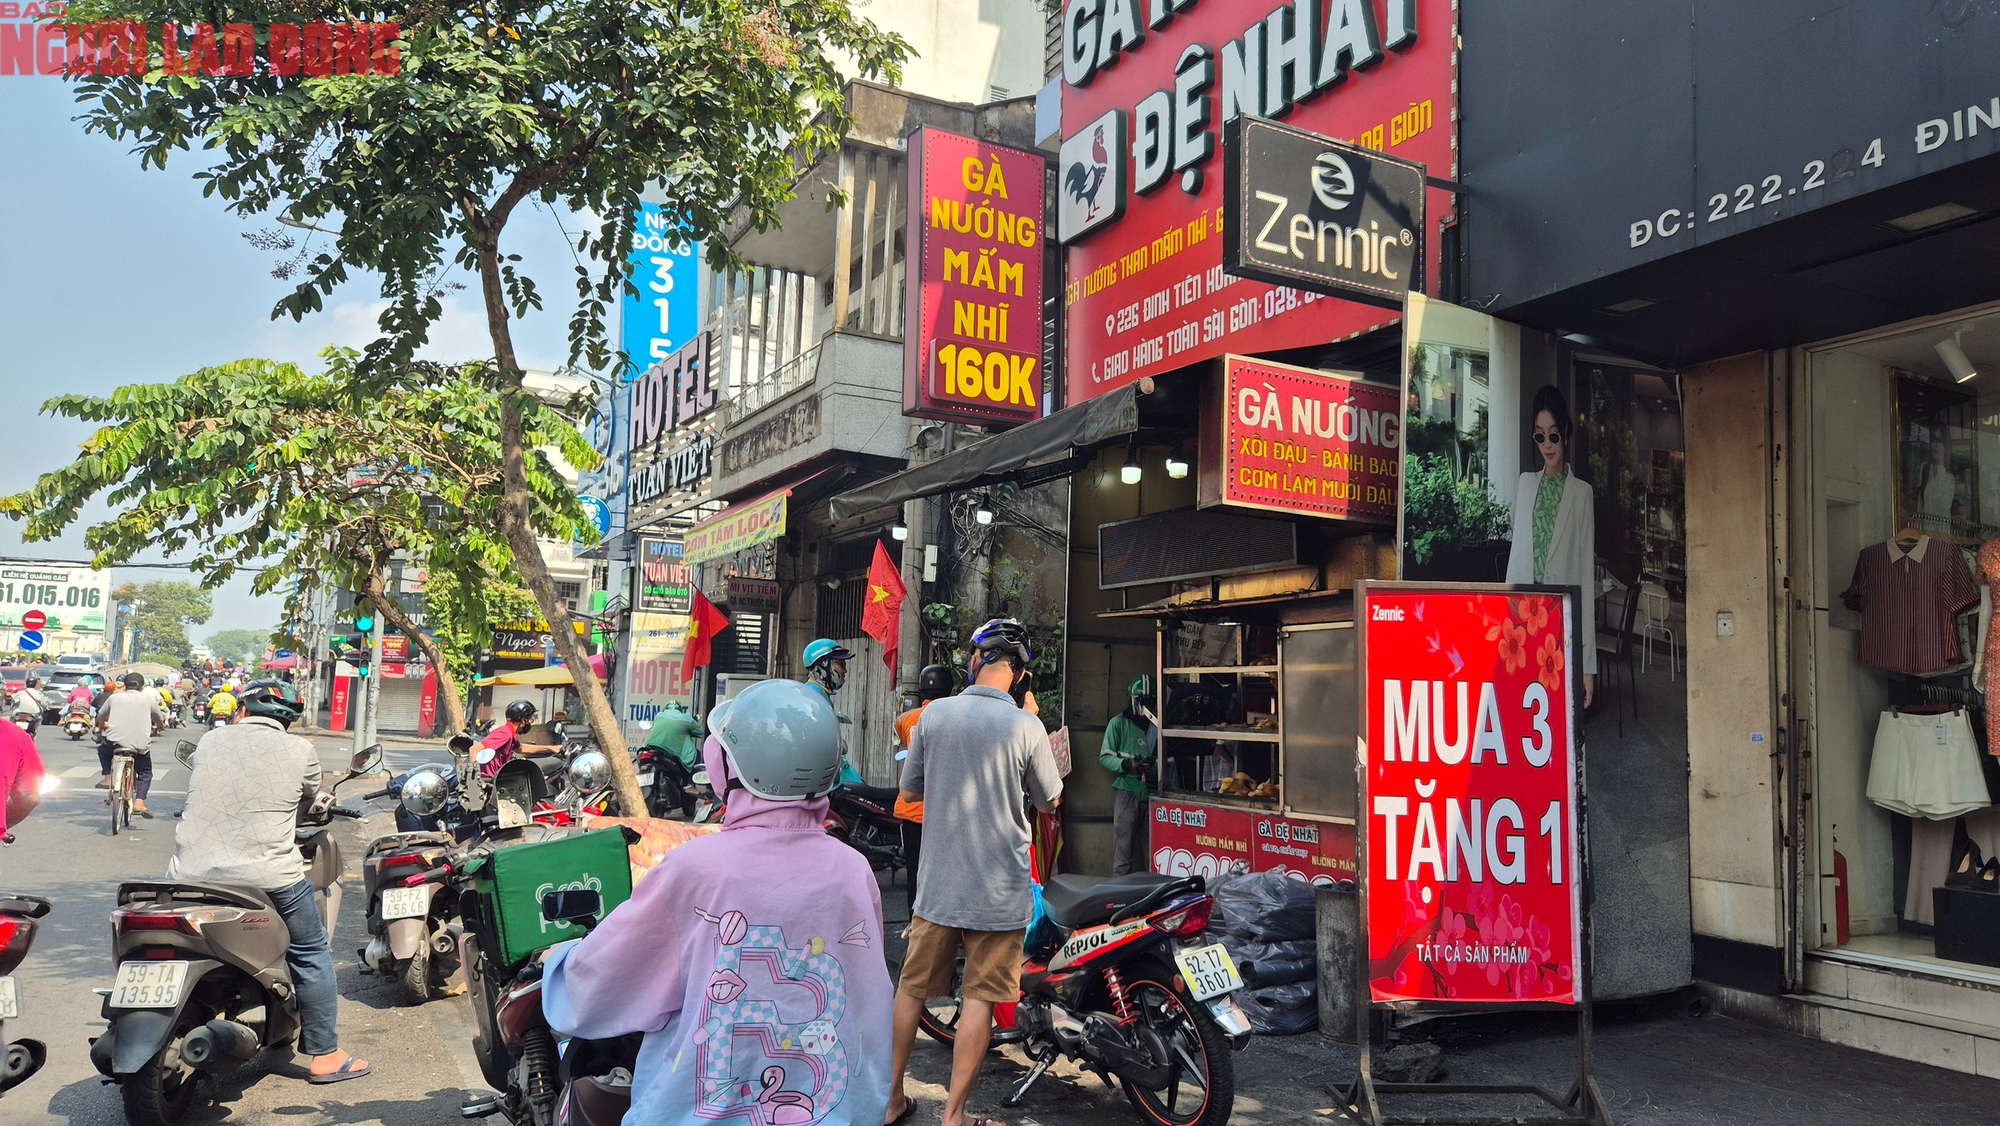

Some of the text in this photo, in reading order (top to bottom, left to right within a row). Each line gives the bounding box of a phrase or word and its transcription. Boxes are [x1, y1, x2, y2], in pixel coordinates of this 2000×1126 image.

[1133, 44, 1213, 195] ĐỆ
[962, 153, 1009, 199] GÀ
[645, 211, 679, 231] NH
[931, 196, 1036, 248] NƯỚNG
[1067, 277, 1080, 306] GÀ
[1083, 263, 1117, 298] NƯỚNG
[1120, 245, 1148, 280] THAN
[1151, 226, 1183, 265] MẮM
[1187, 208, 1209, 247] NHĨ
[1391, 99, 1433, 147] GIÒN
[1629, 208, 1695, 248] ĐC:
[943, 247, 1024, 297] MẮM
[953, 300, 1009, 343] NHĨ
[1116, 302, 1139, 334] 226
[1142, 288, 1170, 322] ĐINH
[1173, 274, 1202, 309] TIÊN
[1103, 350, 1129, 381] GIAO
[1133, 337, 1163, 370] HÀNG
[1166, 319, 1199, 357] TOÀN
[1203, 308, 1225, 343] SÀI
[629, 331, 717, 452] HOTEL
[938, 344, 1037, 407] 160K
[1238, 381, 1400, 449] GÀ NƯỚNG
[628, 443, 667, 506] TUẤN
[670, 433, 711, 491] VIỆT
[1240, 433, 1268, 458] XÔI
[1273, 438, 1307, 468] ĐẬU
[1322, 447, 1364, 472] BÁNH
[1369, 457, 1398, 477] BAO
[1239, 467, 1397, 510] CƠM LAM MUỐI ĐẬU
[650, 542, 685, 557] HOTEL
[685, 508, 769, 554] CƠM TẤM LỘC
[643, 556, 668, 582] TUẤN
[742, 583, 755, 596] VỊT
[1372, 605, 1405, 622] Zennic
[495, 632, 537, 651] Ngọc
[631, 660, 691, 696] HOTEL
[630, 699, 661, 721] TUẤN
[1383, 679, 1553, 768] MUA 3
[1156, 806, 1207, 828] GÀ ĐỆ NHẤT
[1258, 820, 1320, 844] GÀ ĐỆ NHẤT
[1373, 778, 1563, 905] TẶNG 1
[387, 901, 424, 916] 456.46
[390, 889, 422, 903] 59-F2
[1063, 930, 1108, 960] REPSOL
[1416, 935, 1528, 965] TẤT CẢ SẢN PHẨM
[127, 963, 174, 983] 59-TA
[1194, 968, 1235, 996] 3607
[118, 985, 175, 1005] 135.95
